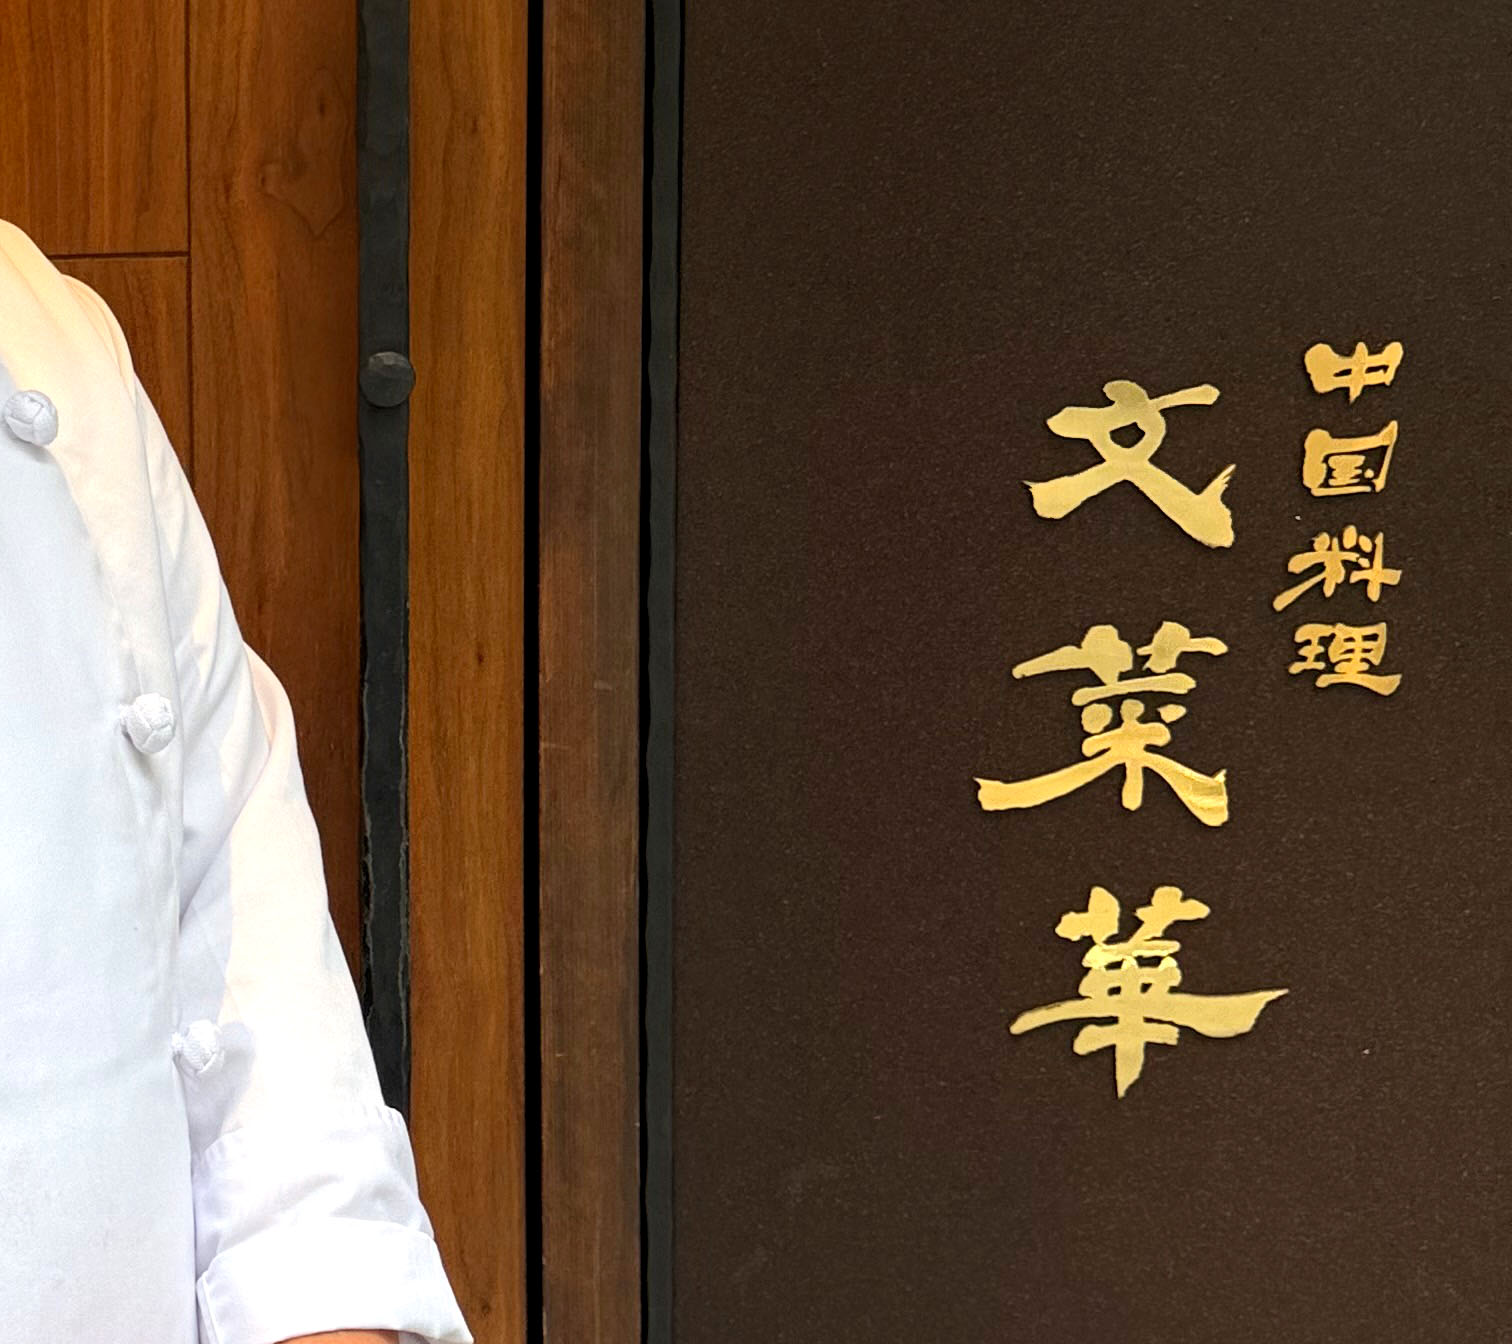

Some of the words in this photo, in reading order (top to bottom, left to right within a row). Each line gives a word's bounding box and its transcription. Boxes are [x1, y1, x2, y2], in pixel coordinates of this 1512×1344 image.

[973, 379, 1289, 1099] 文菜華
[1272, 341, 1405, 696] 中国料理
